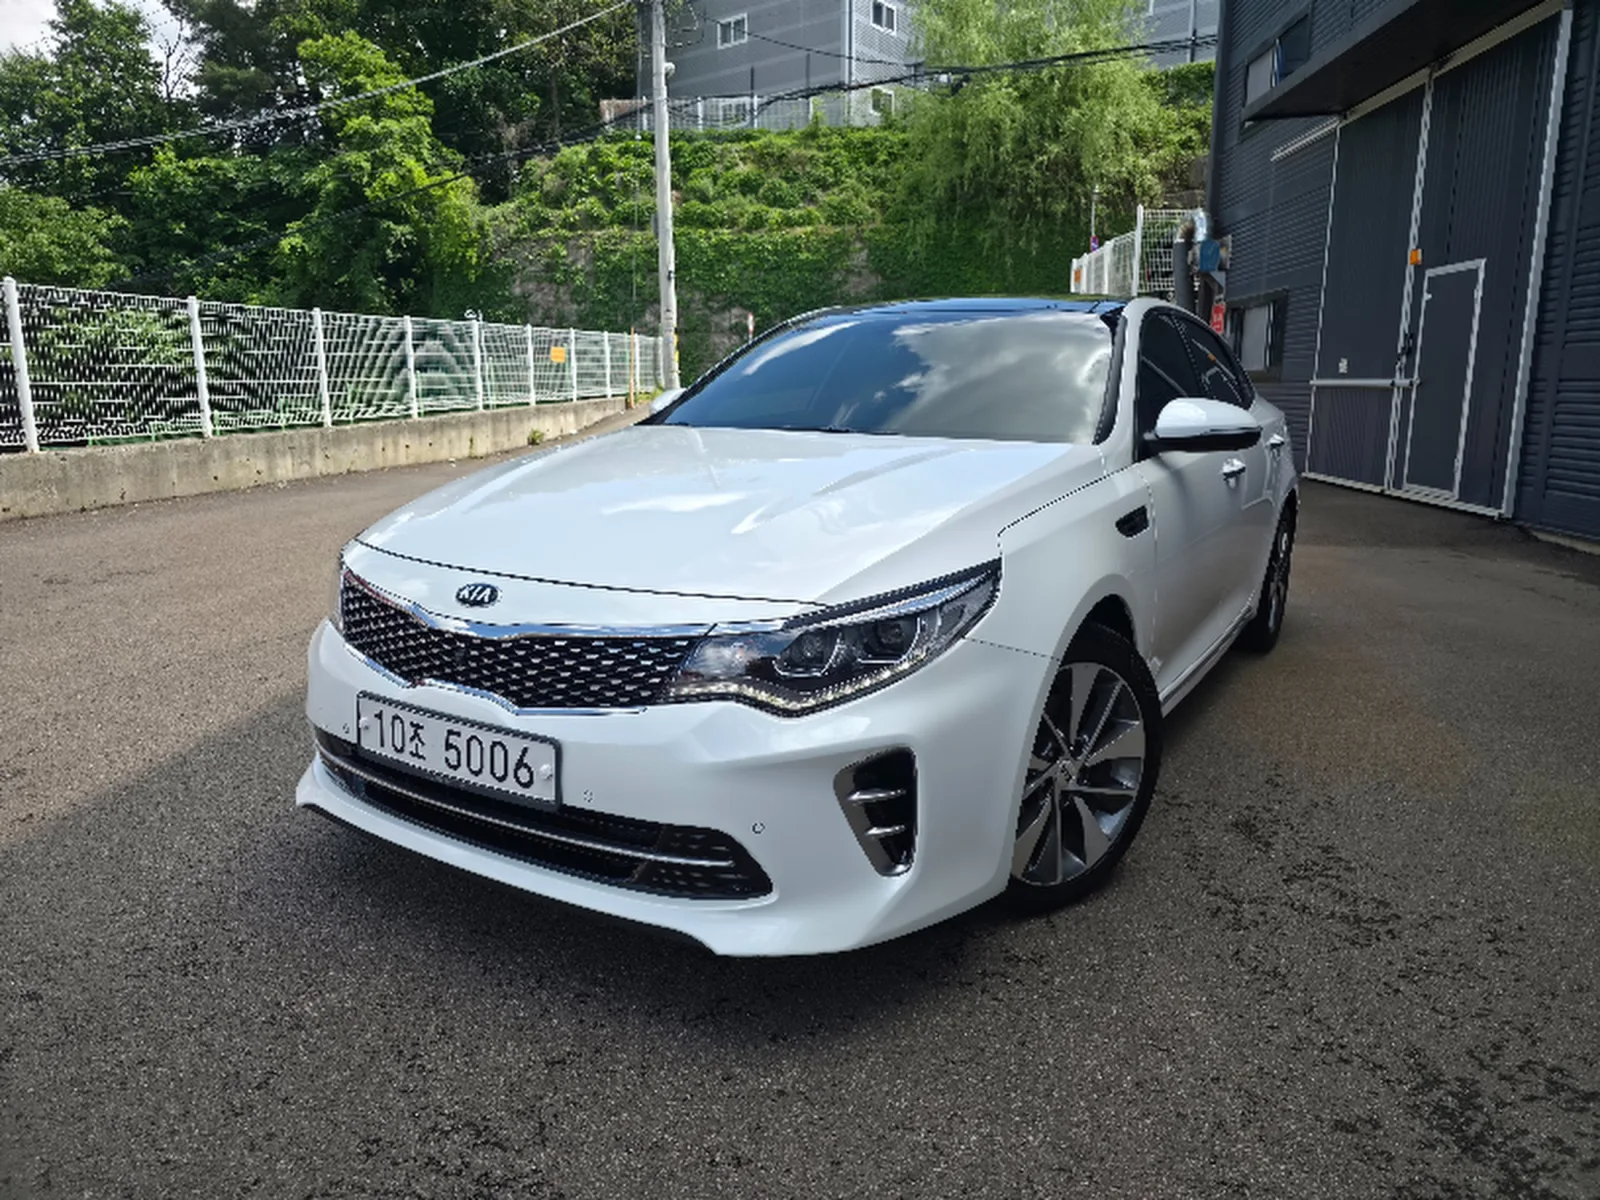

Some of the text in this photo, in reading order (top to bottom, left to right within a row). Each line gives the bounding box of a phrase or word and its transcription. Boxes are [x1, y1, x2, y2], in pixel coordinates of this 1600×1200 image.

[458, 585, 494, 604] KIA
[374, 709, 534, 789] 10조 5006
